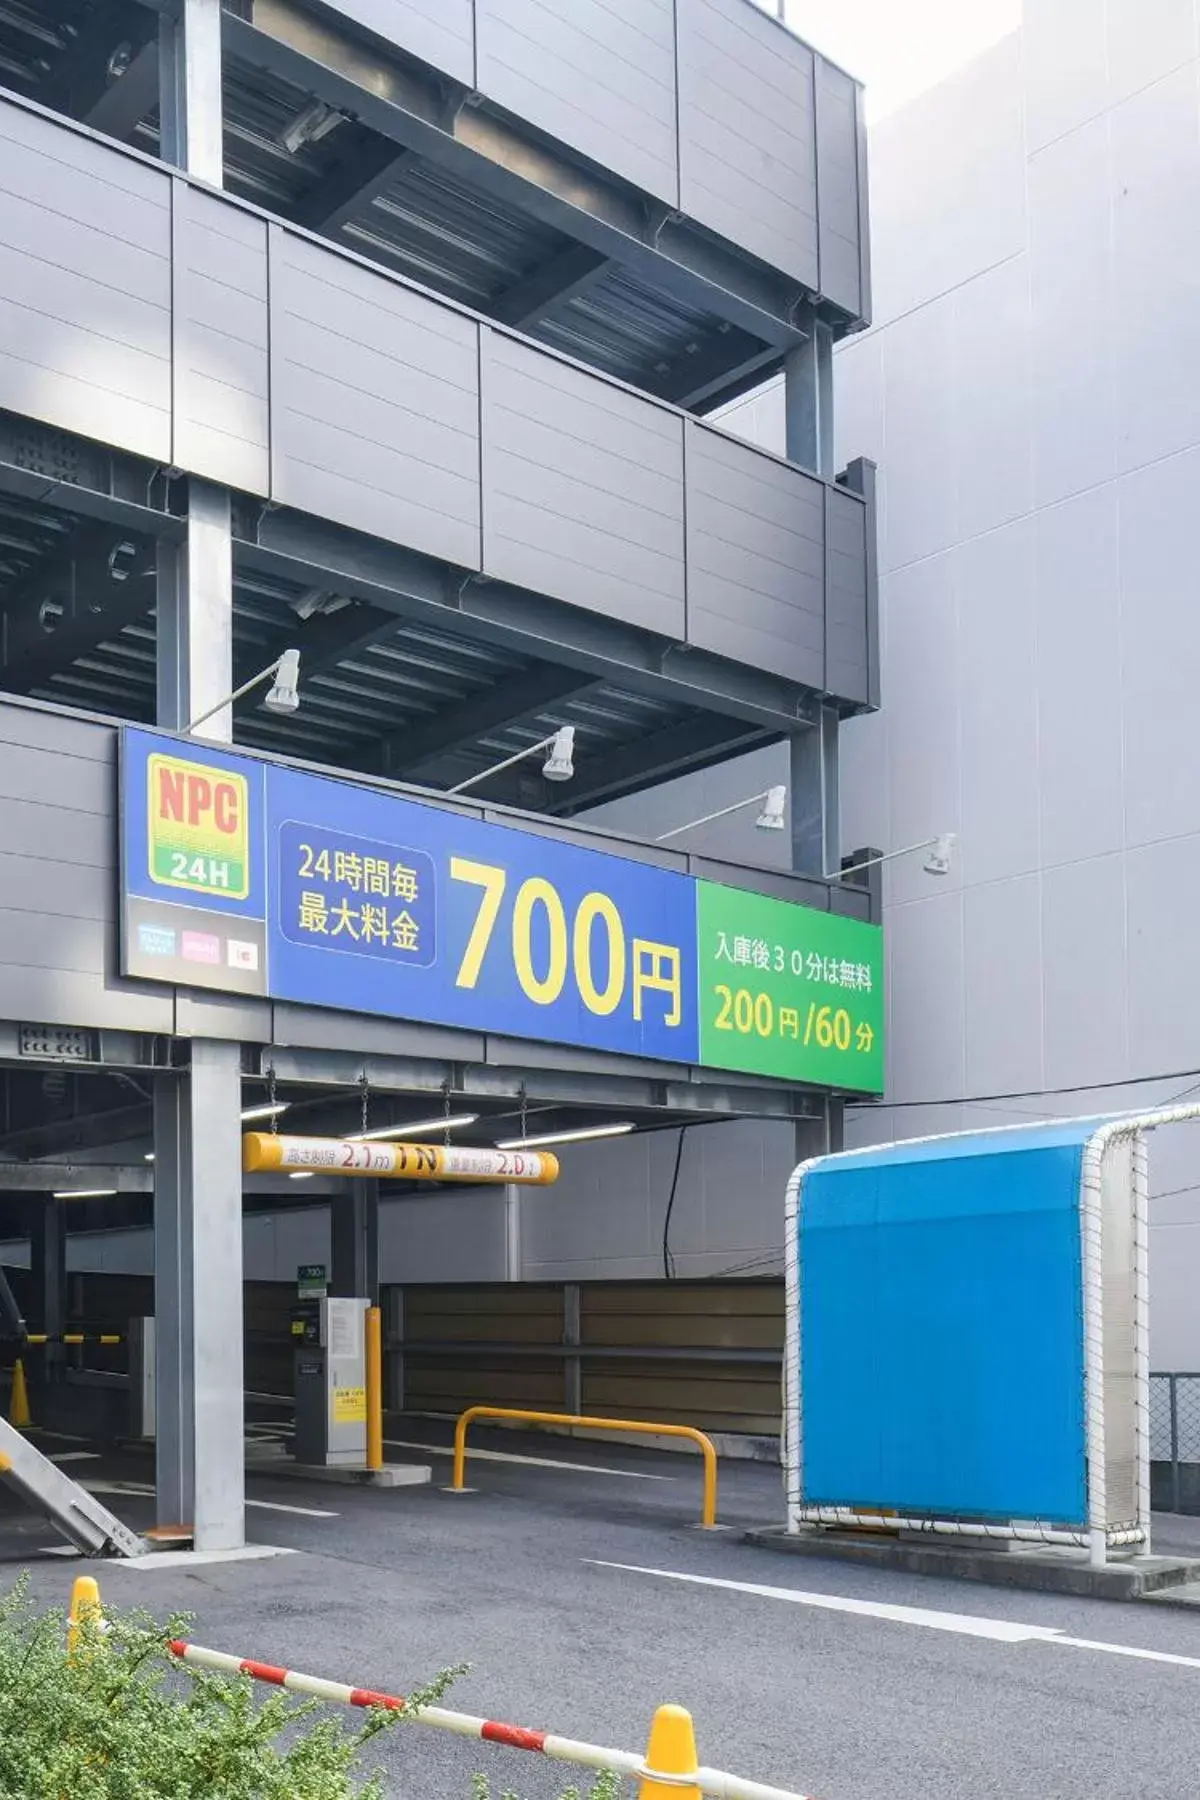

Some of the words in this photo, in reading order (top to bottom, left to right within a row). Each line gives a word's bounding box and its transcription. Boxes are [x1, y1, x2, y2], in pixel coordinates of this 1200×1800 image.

[159, 767, 238, 834] NPC
[170, 852, 229, 888] 24H
[298, 843, 419, 903] 24時間毎
[298, 890, 420, 951] 最大料金
[450, 856, 682, 1027] 700円
